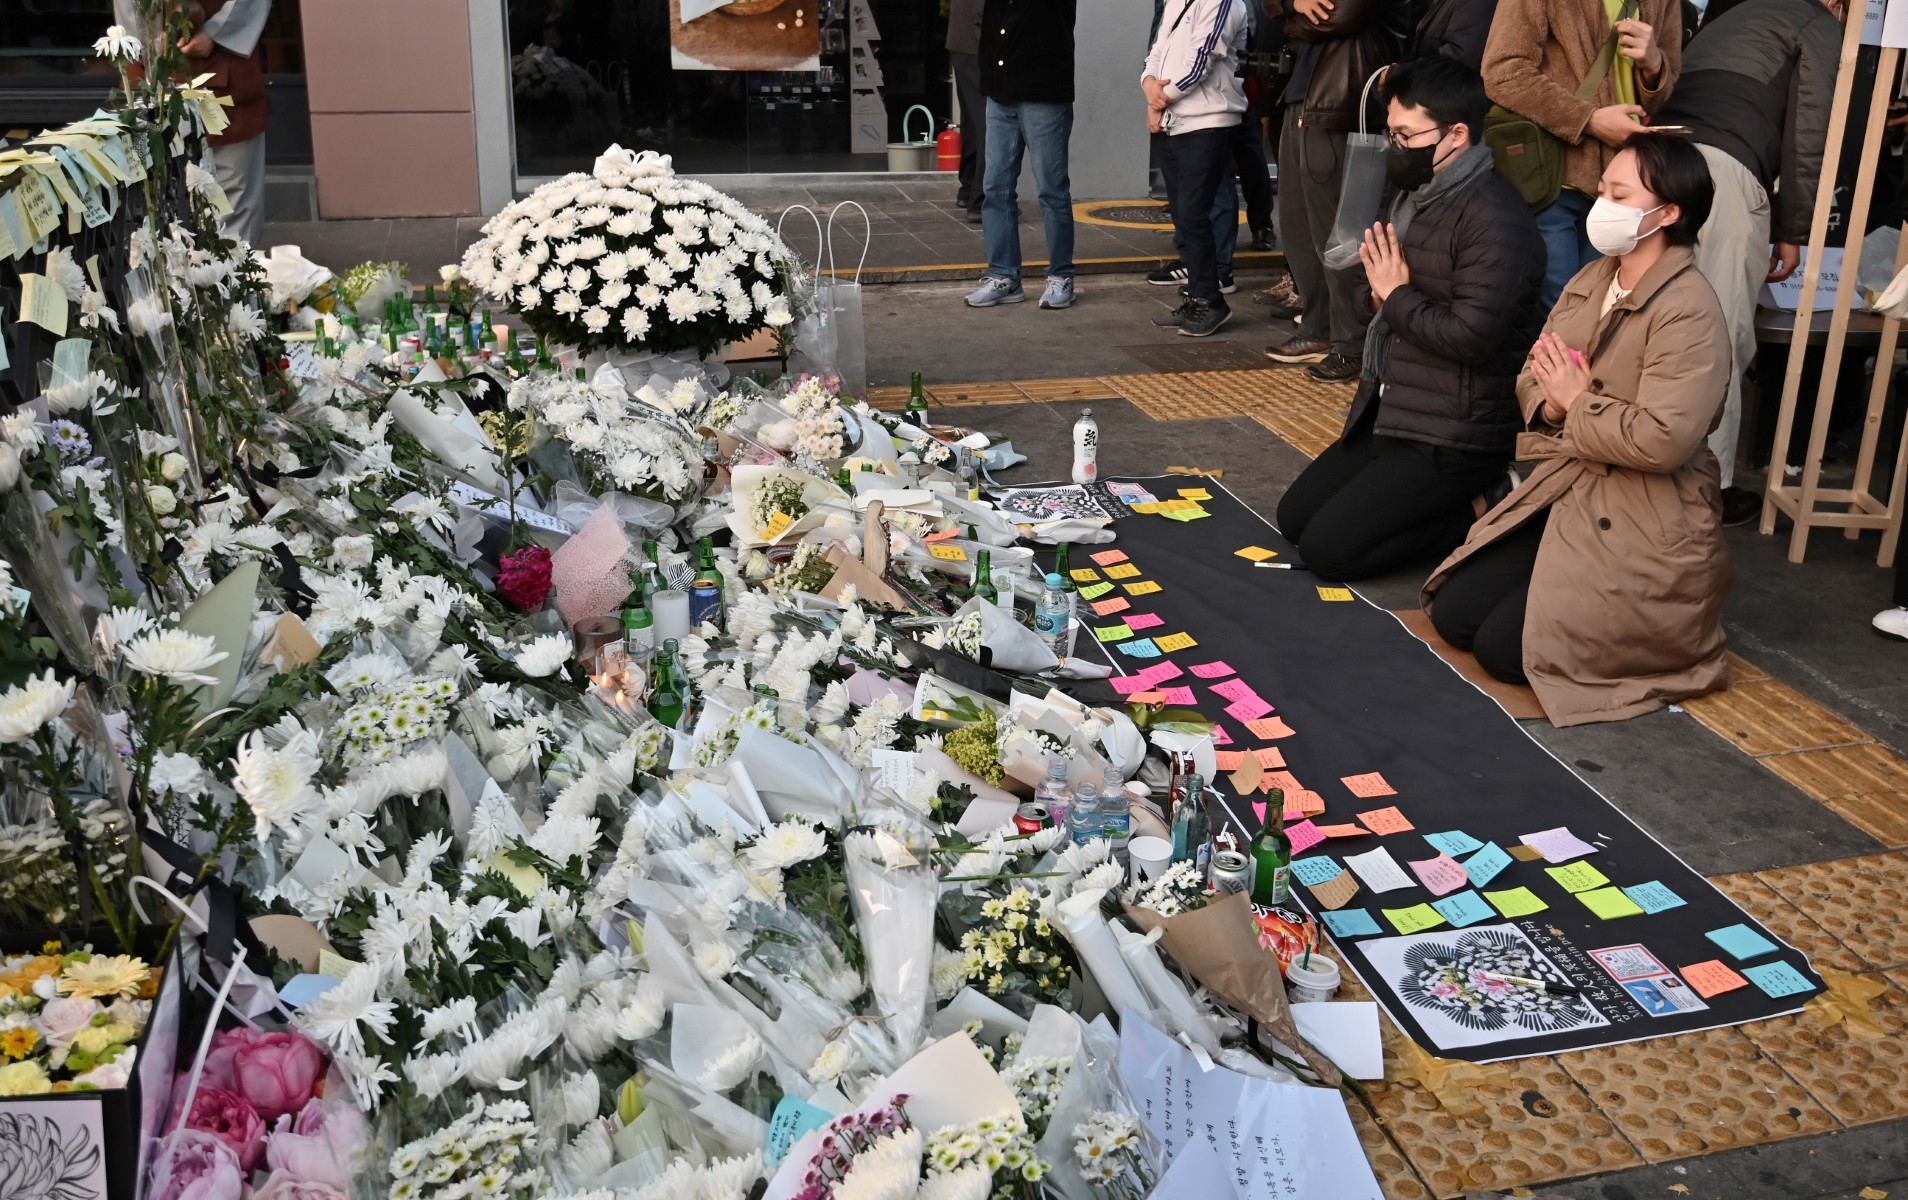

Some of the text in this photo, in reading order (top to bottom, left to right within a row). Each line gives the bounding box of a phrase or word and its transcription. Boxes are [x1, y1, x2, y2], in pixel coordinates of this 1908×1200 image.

[1520, 921, 1551, 943] 빕니다
[1545, 924, 1571, 945] pee
[1575, 954, 1595, 969] rest
[1572, 974, 1609, 1001] 故人의
[1593, 971, 1623, 998] he/she
[1603, 1005, 1630, 1022] 삼가
[1621, 1001, 1643, 1017] May
[1228, 1116, 1248, 1187] 정말 사랑한다.
[1255, 1136, 1278, 1199] 가족을 대신해
